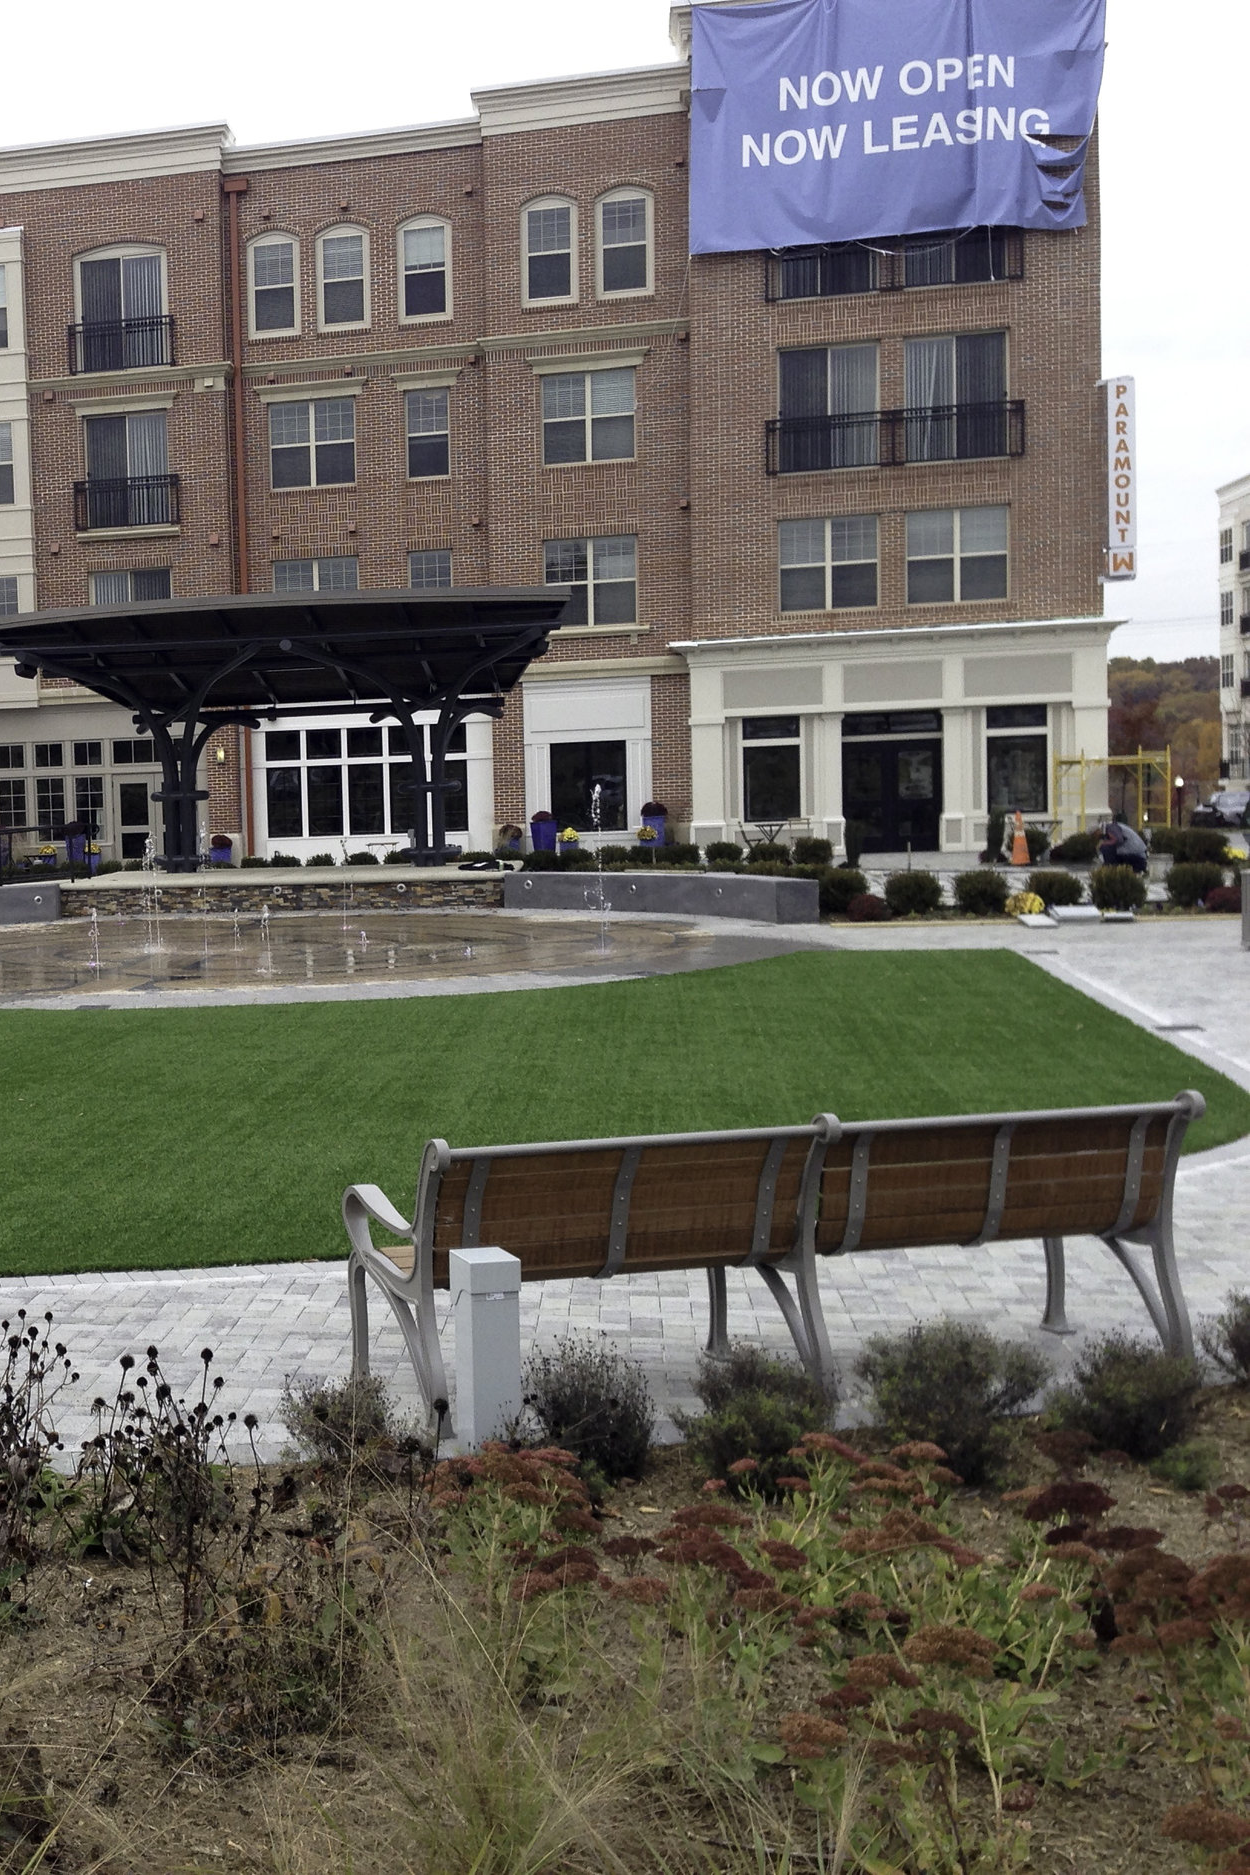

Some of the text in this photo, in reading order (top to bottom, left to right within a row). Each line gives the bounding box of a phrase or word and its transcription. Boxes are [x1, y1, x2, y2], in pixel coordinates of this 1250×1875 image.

[779, 54, 1015, 111] NOW OPEN
[742, 106, 1050, 167] NOW LEASING
[1114, 385, 1131, 542] PARAMOUNT
